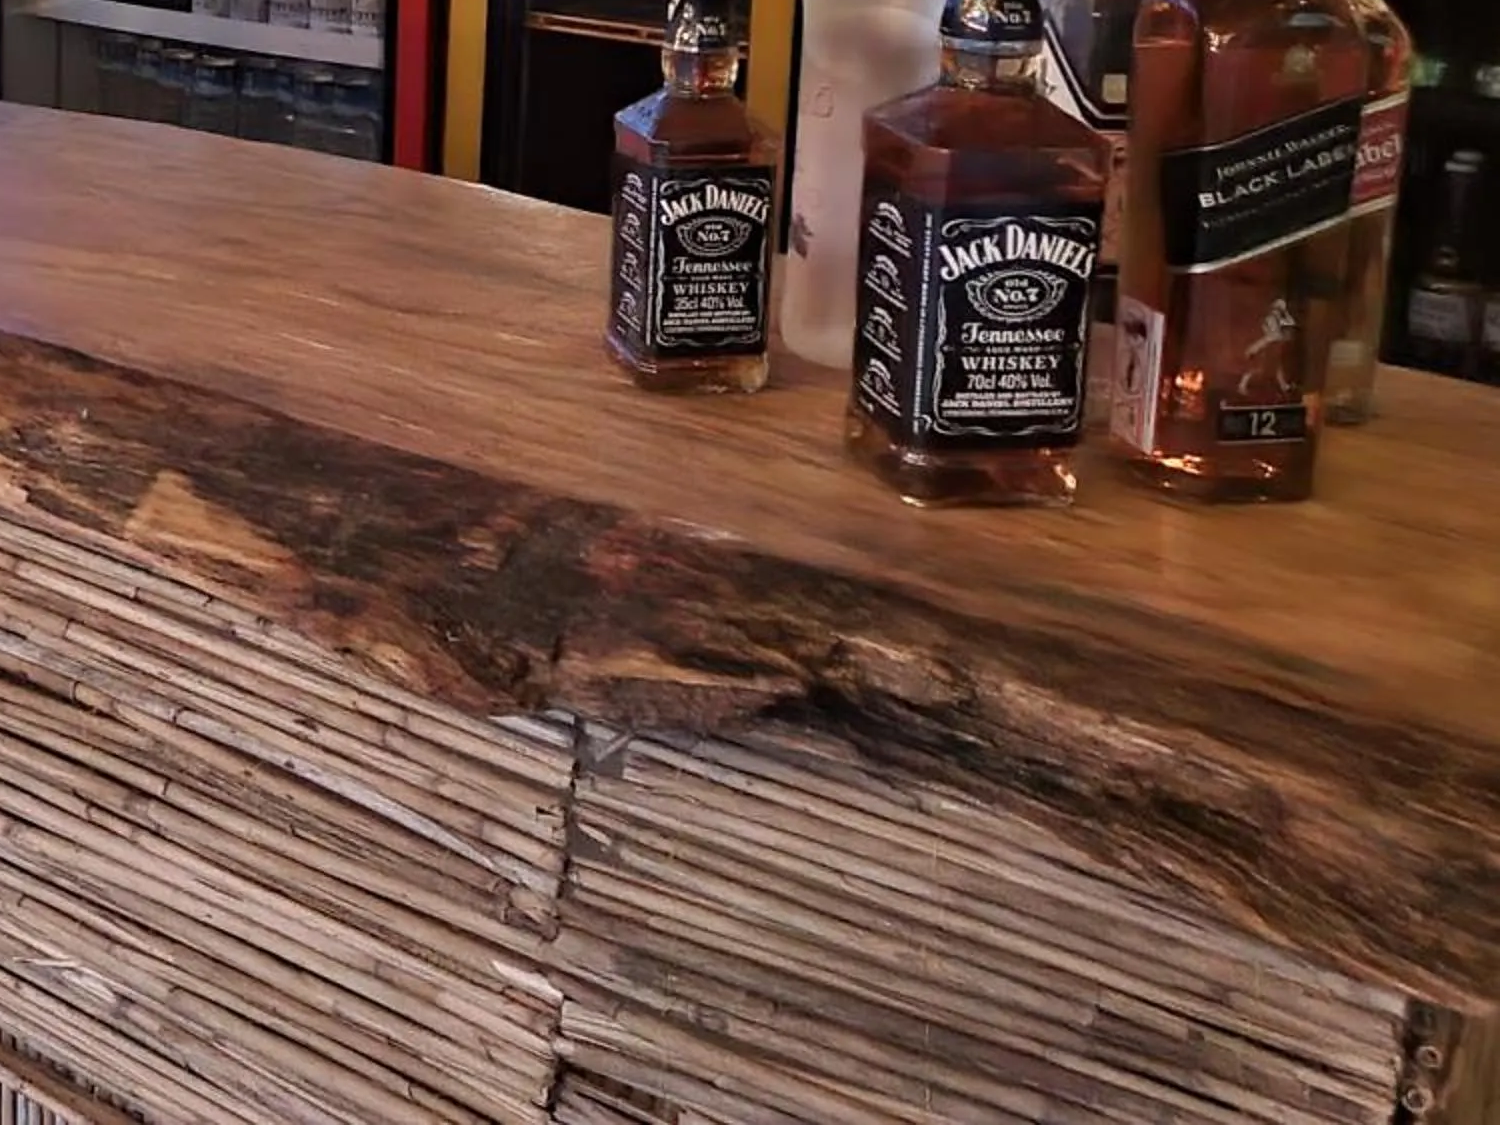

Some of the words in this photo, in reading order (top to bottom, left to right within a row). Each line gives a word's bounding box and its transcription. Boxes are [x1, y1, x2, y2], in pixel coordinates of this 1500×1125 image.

[1198, 170, 1280, 209] BLACK
[659, 192, 704, 226] JACK
[705, 184, 770, 224] DANIEL'S
[938, 233, 1003, 281] JACK
[1005, 224, 1096, 279] DANIEL'S
[672, 256, 752, 274] Tennessee
[673, 282, 749, 295] WHISKEY
[992, 287, 1039, 304] No.7
[961, 322, 1065, 344] Tennessee
[961, 355, 1061, 370] WHISKEY
[1249, 410, 1277, 436] 12
